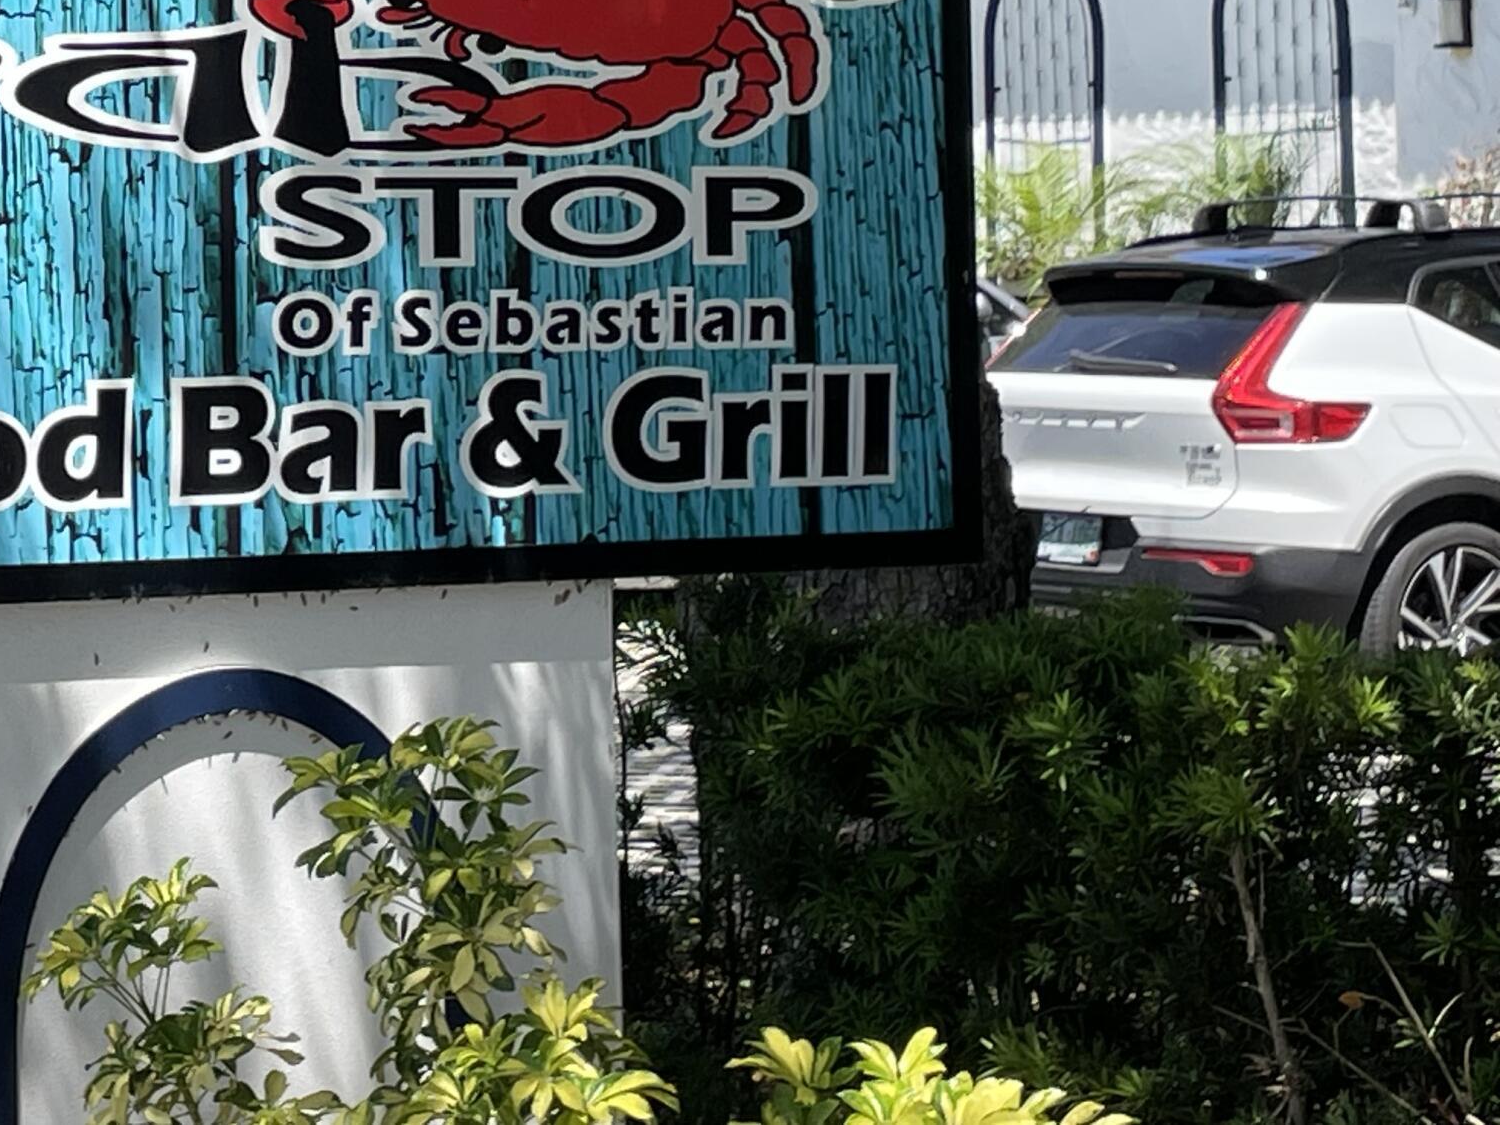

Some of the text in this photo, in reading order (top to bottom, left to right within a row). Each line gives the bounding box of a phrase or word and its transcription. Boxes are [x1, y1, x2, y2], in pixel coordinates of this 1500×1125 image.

[260, 164, 818, 268] STOP
[272, 288, 795, 356] Of Sebastian
[169, 375, 433, 506] Bar
[461, 369, 583, 498] &
[604, 362, 898, 491] Grill
